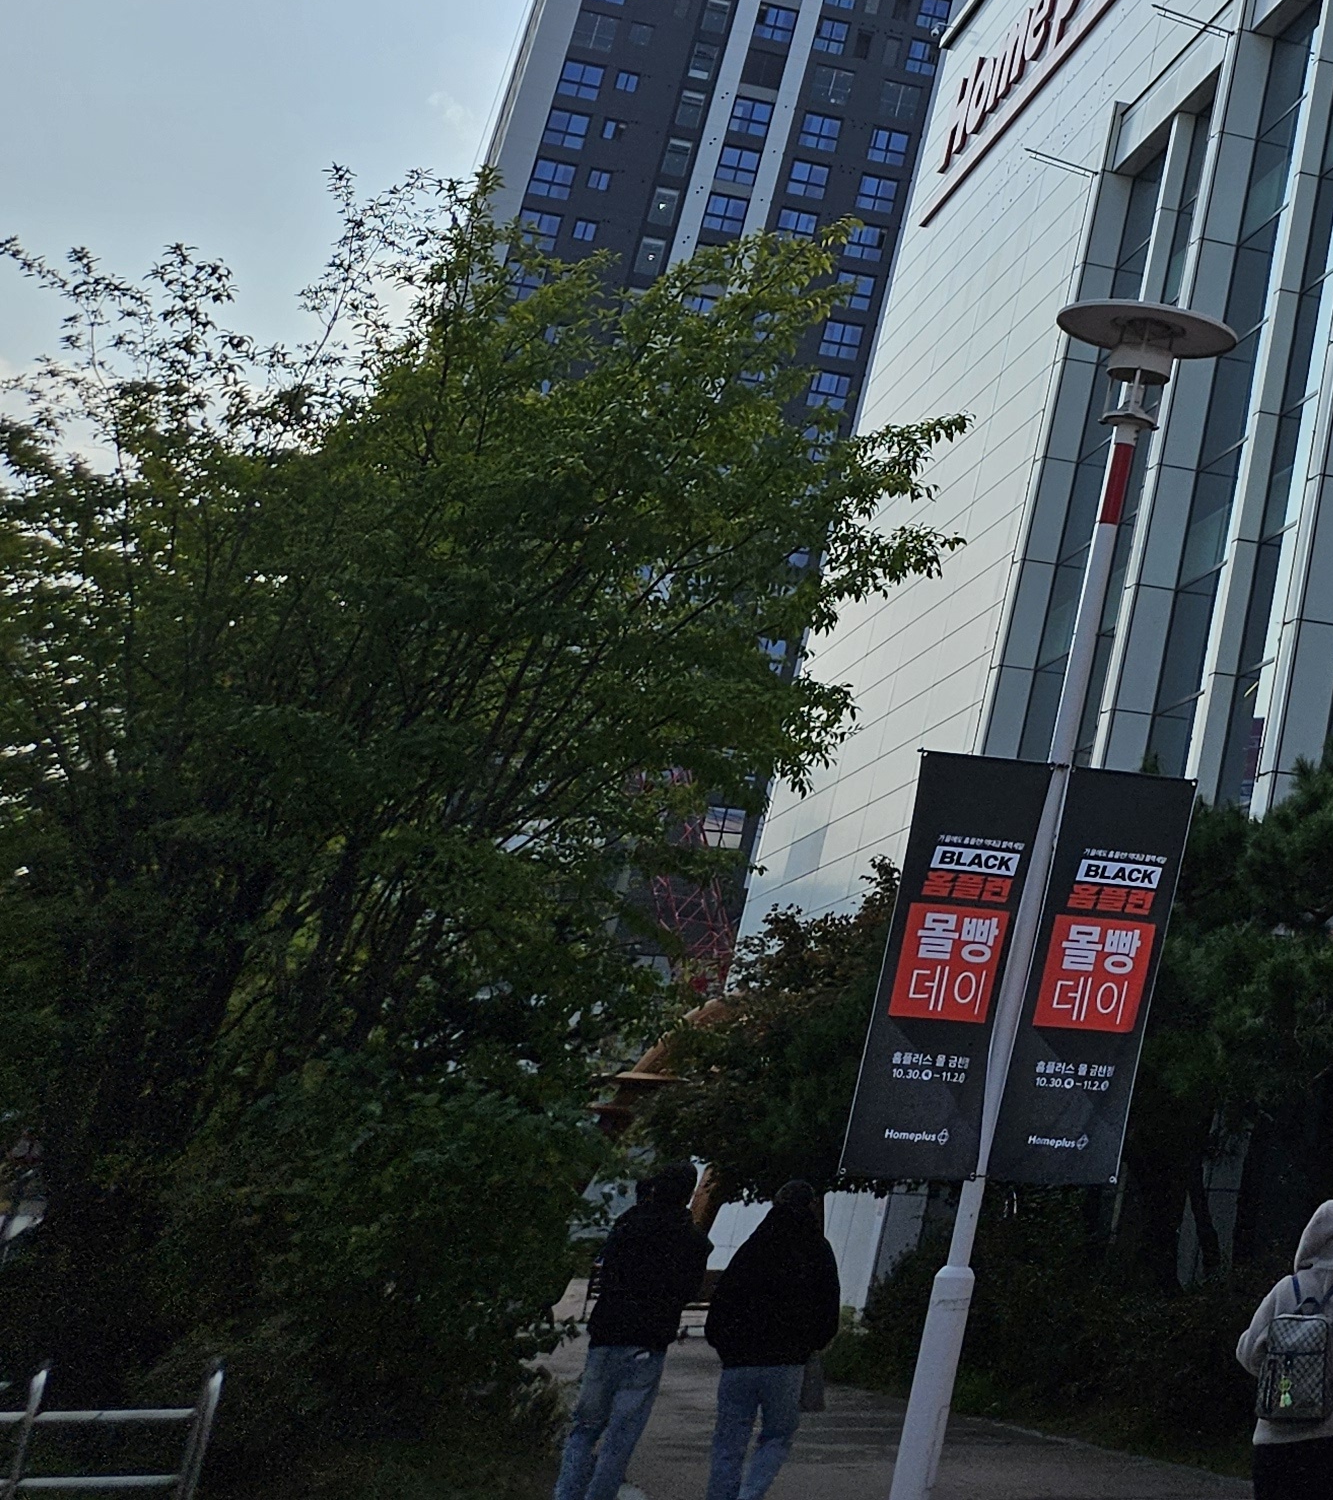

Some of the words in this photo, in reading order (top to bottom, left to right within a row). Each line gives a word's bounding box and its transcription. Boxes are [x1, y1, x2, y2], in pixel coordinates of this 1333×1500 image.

[939, 850, 1013, 872] BLACK
[1084, 864, 1156, 885] BLACK
[921, 870, 1014, 903] 홈플런
[1066, 884, 1156, 916] 홈플런
[917, 911, 999, 964] 몰빵
[1062, 924, 1141, 975] 몰빵
[908, 965, 987, 1017] 데이
[1052, 976, 1129, 1025] 데이
[892, 1051, 933, 1066] 홈플러스
[1035, 1060, 1075, 1075] 홈플러스
[884, 1128, 937, 1143] Homeplus
[1028, 1134, 1076, 1149] Homeplus
